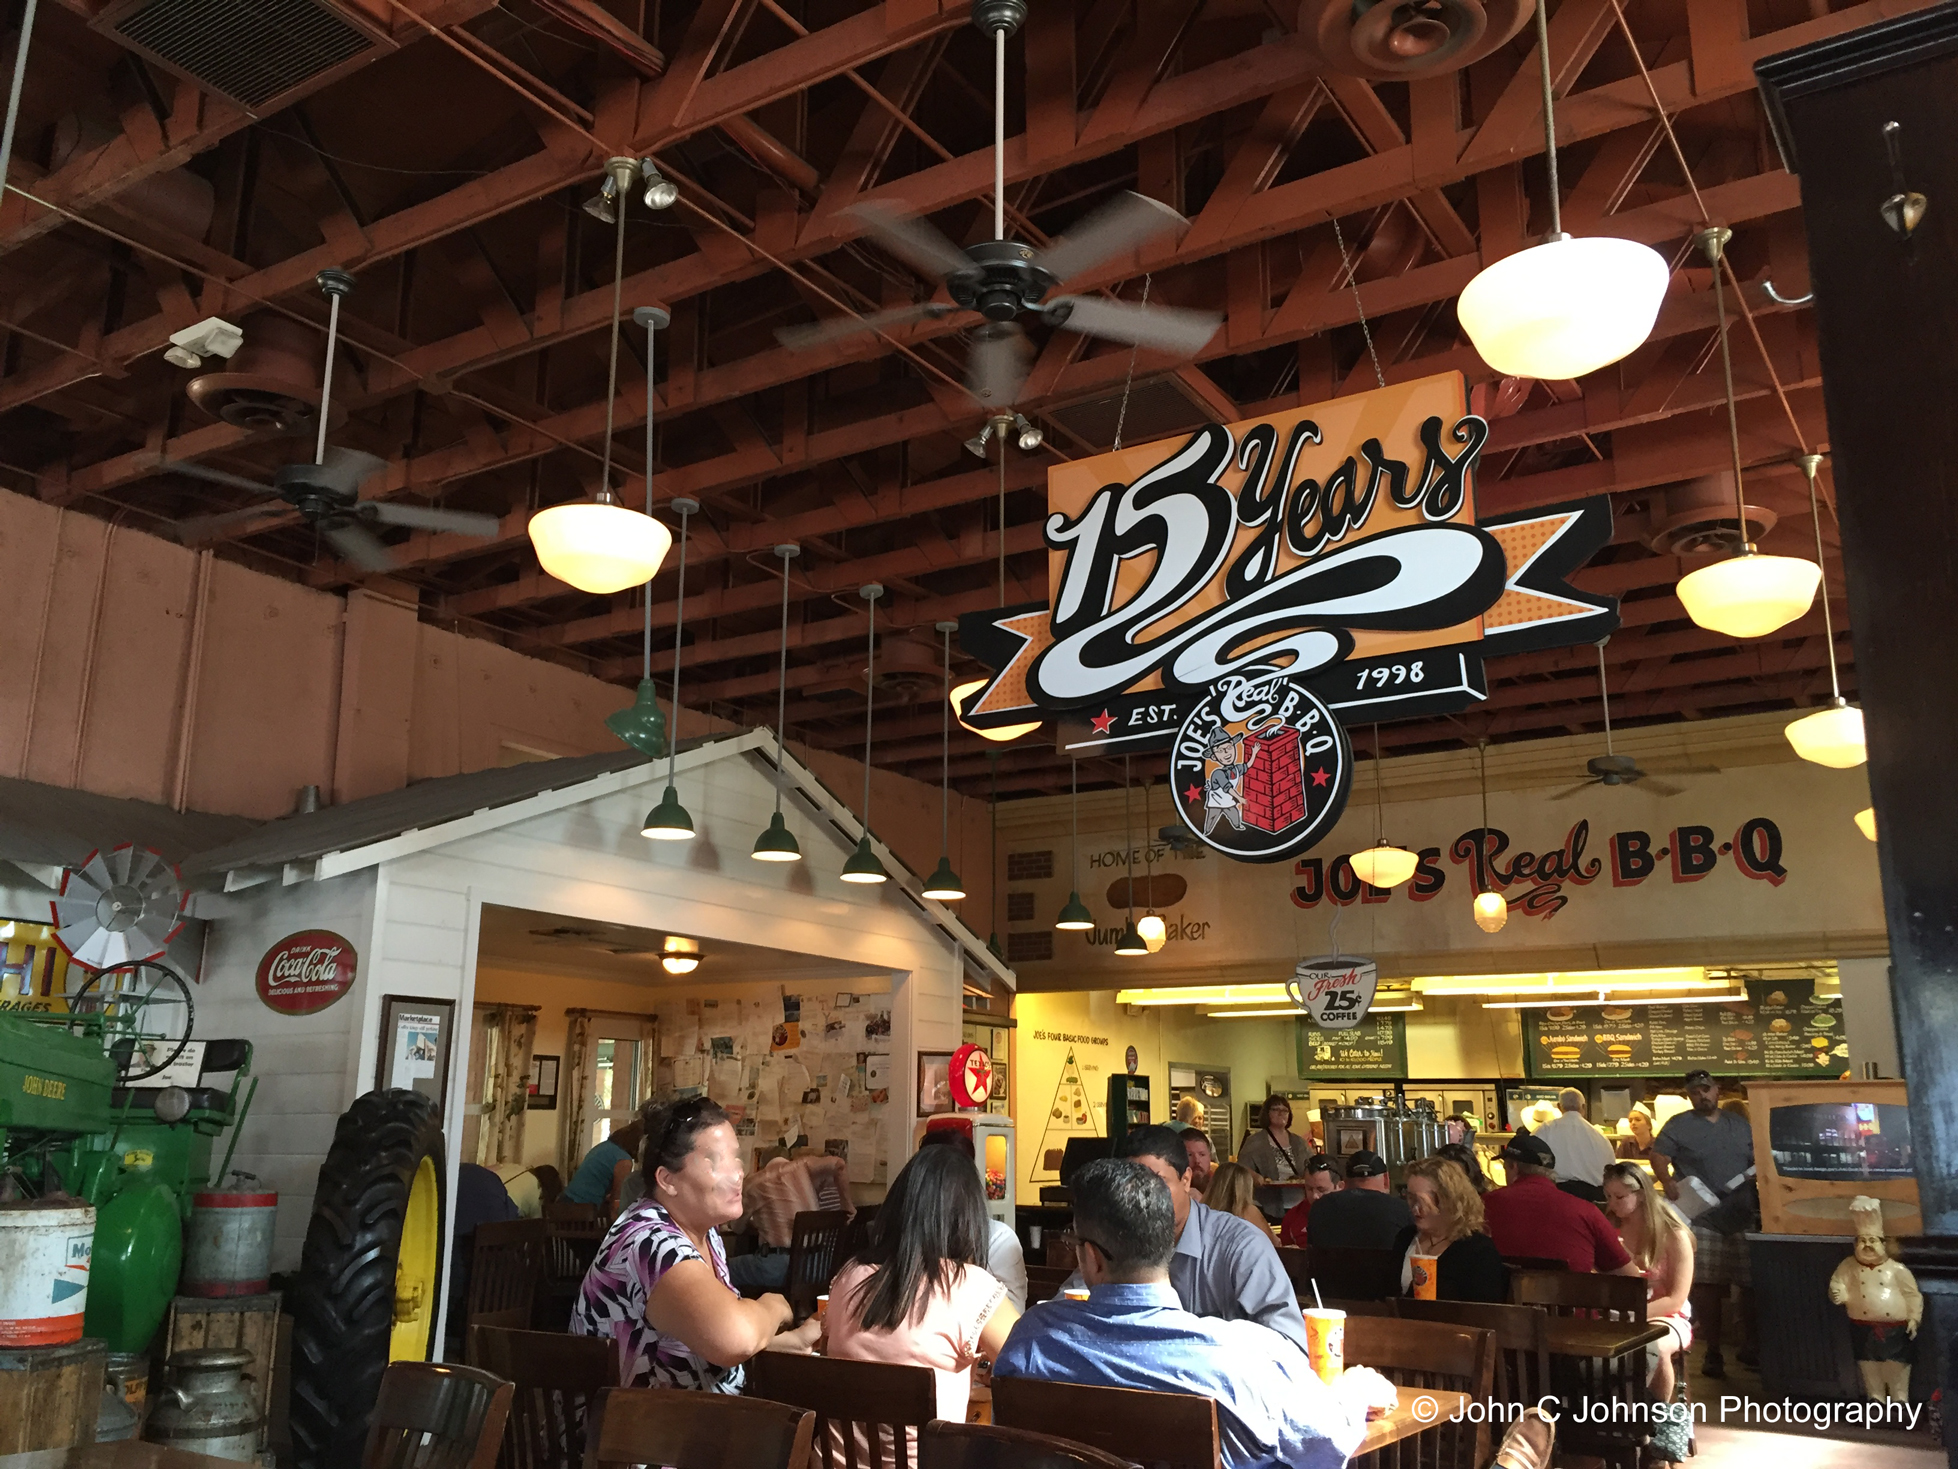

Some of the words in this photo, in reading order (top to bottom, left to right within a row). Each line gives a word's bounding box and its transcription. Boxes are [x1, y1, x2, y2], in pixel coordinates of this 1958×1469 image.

[1042, 423, 1237, 698] 15
[1226, 415, 1490, 600] Years
[1128, 704, 1178, 726] EST.
[1356, 661, 1425, 691] 1998
[1177, 705, 1223, 772] JOE'S
[1220, 675, 1283, 708] Real
[1089, 850, 1140, 869] HOME
[1144, 848, 1165, 864] OF
[1449, 818, 1602, 898] Real
[290, 946, 312, 954] DRINK
[1307, 967, 1363, 1002] Fresh
[1309, 972, 1330, 980] OUR
[268, 987, 294, 996] DELICIOUS
[294, 986, 305, 994] AND
[306, 984, 339, 993] REFRESHING
[399, 1015, 433, 1023] Marketplace
[1320, 1012, 1358, 1021] COFFEE
[1033, 1029, 1046, 1040] JOE'S
[1047, 1032, 1062, 1042] FOUR
[1062, 1033, 1077, 1043] BASIC
[1077, 1035, 1090, 1044] FOOD
[1090, 1037, 1109, 1046] GROUPS
[23, 1075, 43, 1095] JOHN
[43, 1079, 67, 1100] DEERE
